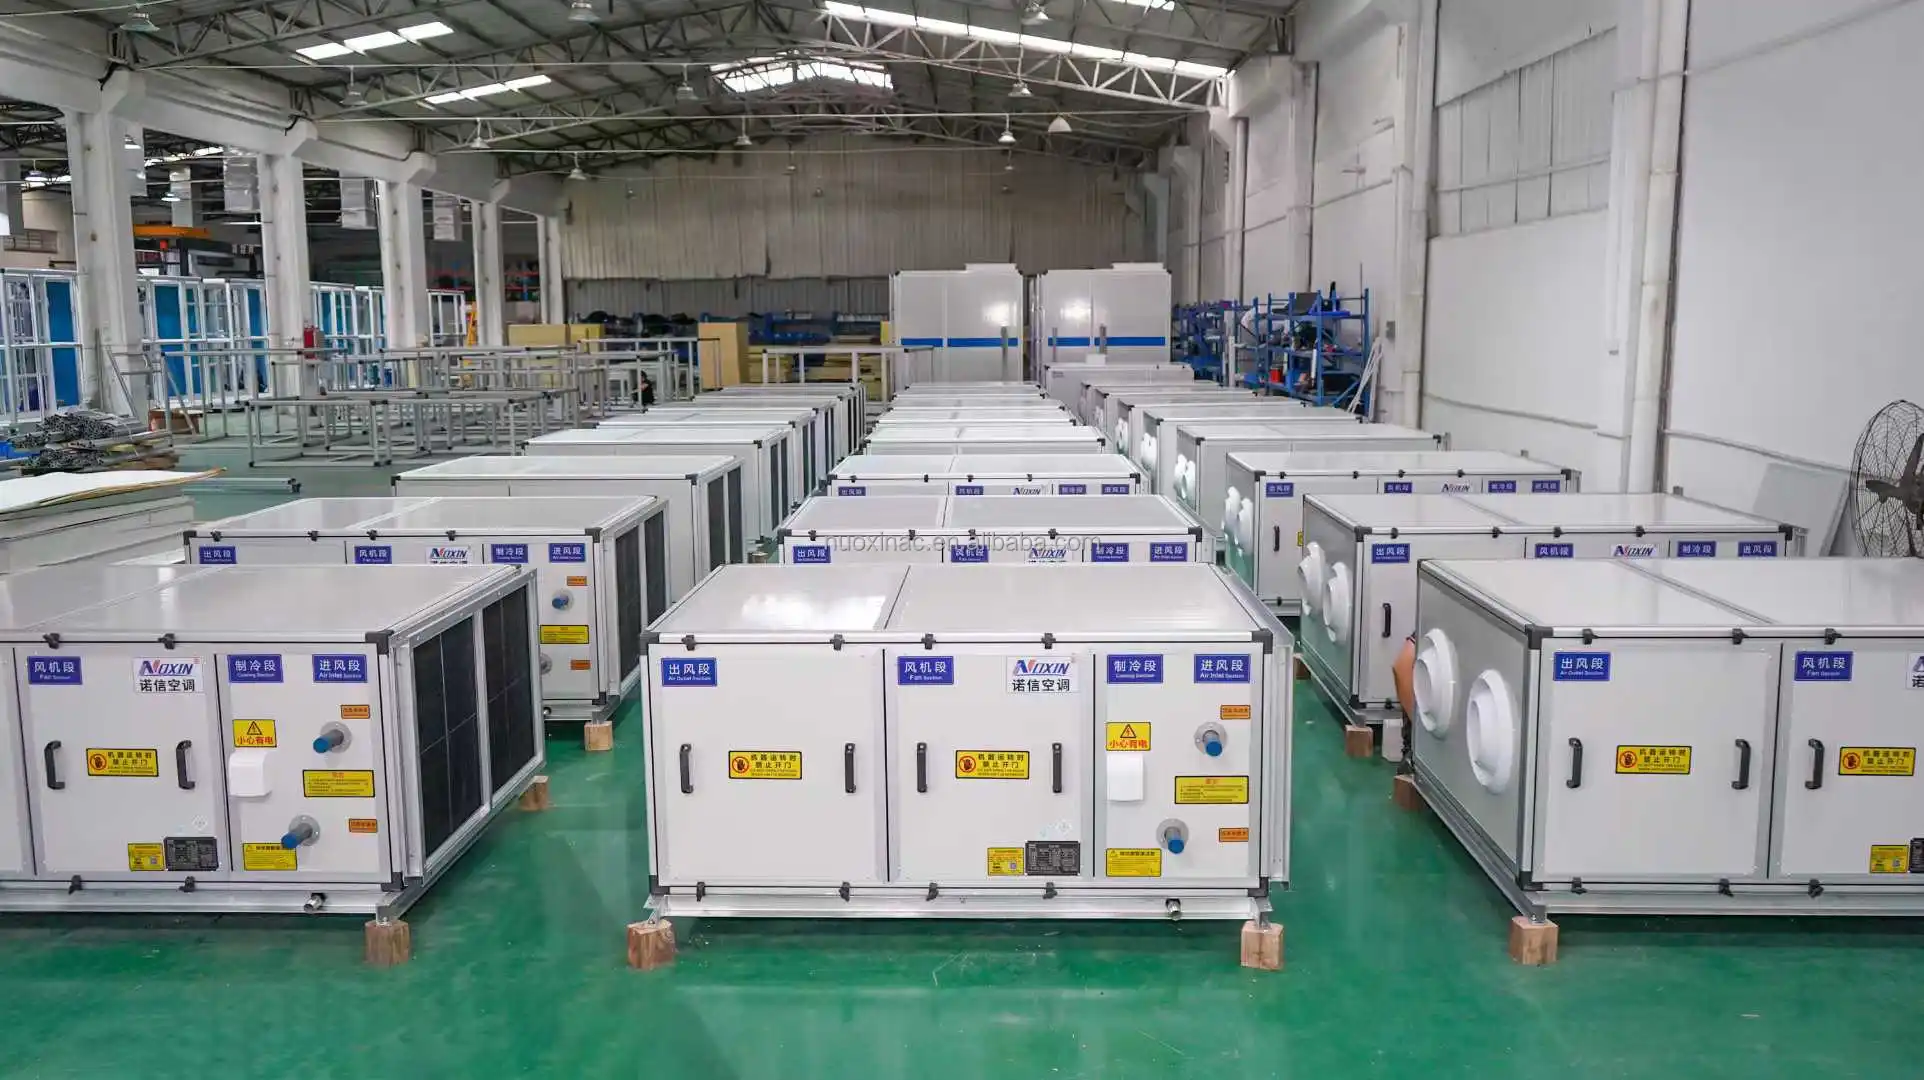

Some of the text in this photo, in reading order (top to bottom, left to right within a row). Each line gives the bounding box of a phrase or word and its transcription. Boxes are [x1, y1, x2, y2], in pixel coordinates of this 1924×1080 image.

[34, 661, 76, 673] 风机段
[235, 659, 276, 672] 制冷段
[319, 659, 361, 672] 进风段
[669, 663, 710, 675] 出风段
[904, 661, 947, 673] 风机段
[1113, 659, 1157, 672] 制冷段
[1201, 659, 1244, 672] 进风段
[1561, 657, 1604, 670] 出风段
[1802, 657, 1845, 669] 风机段
[139, 679, 195, 692] 诺信空调
[1012, 679, 1070, 692] 诺信空调
